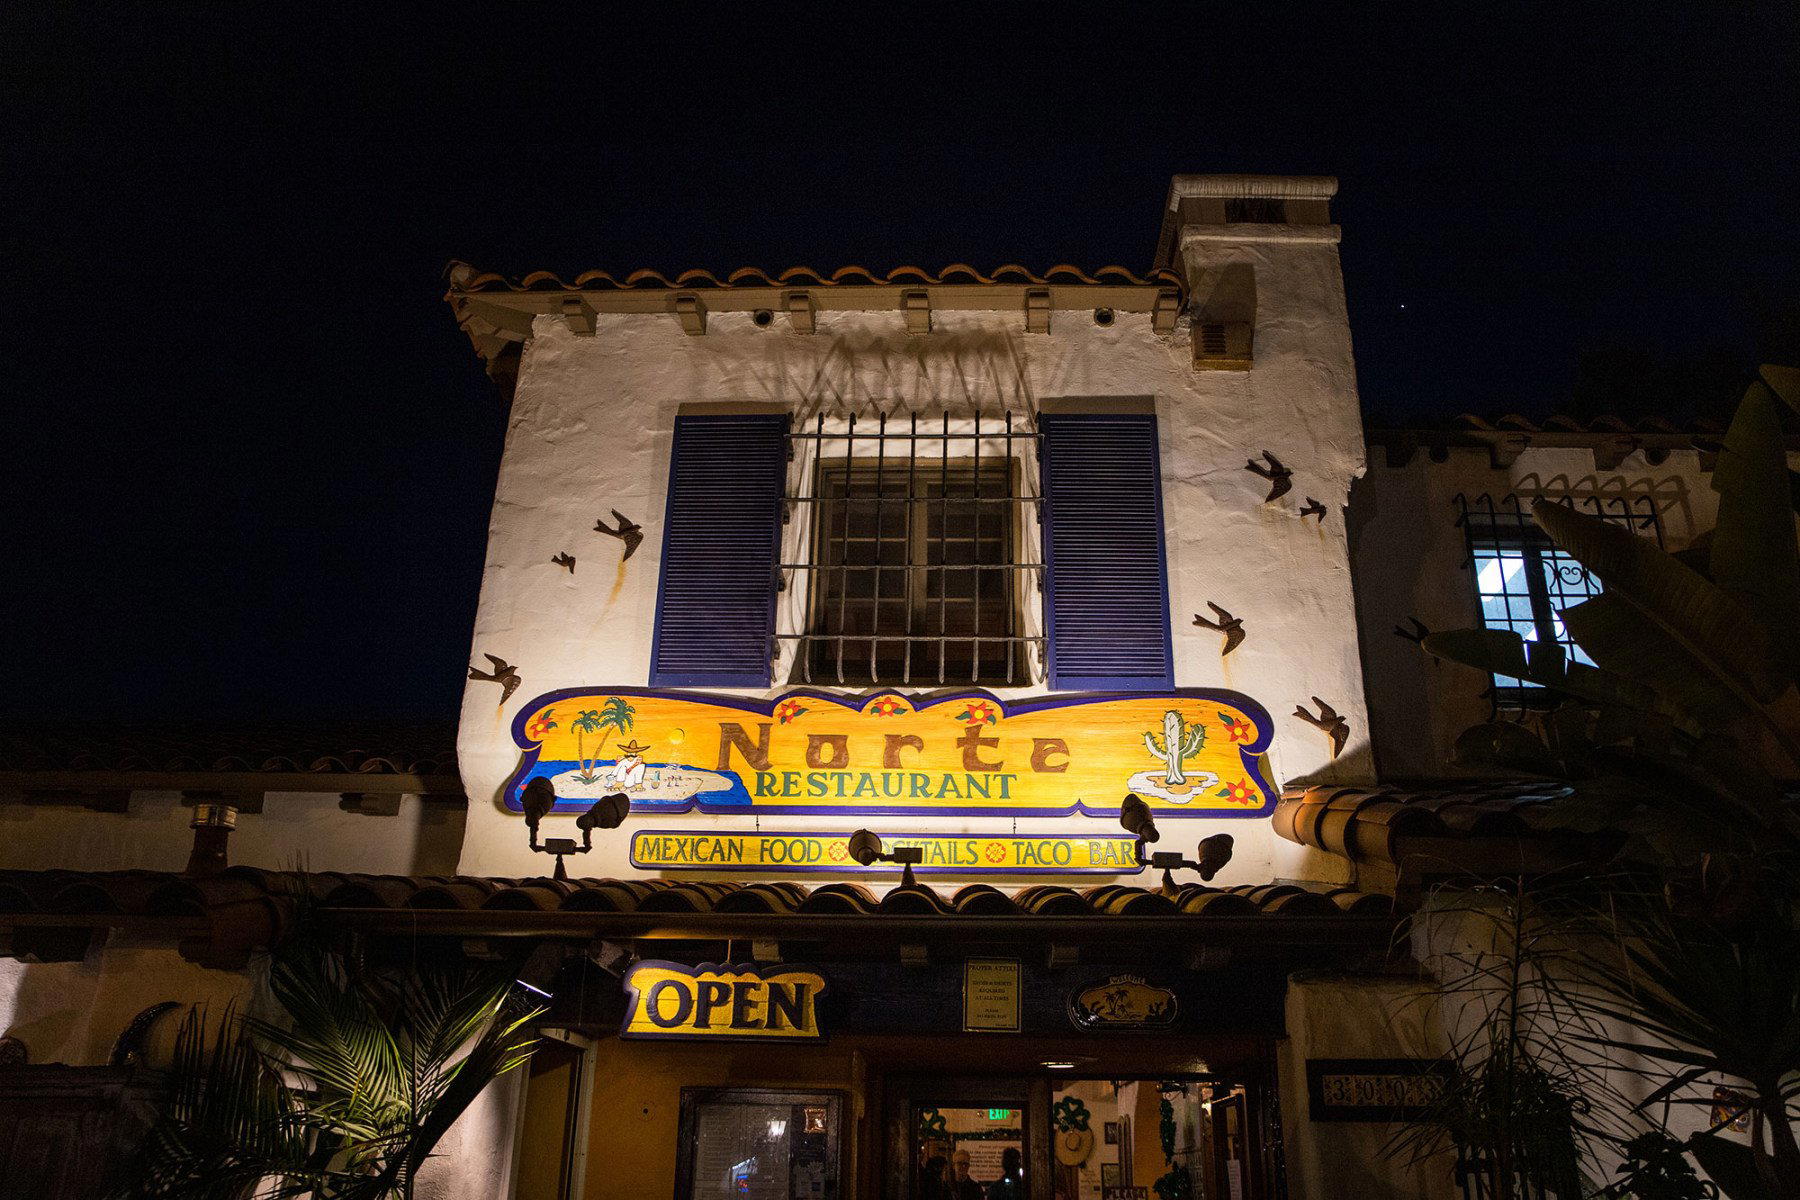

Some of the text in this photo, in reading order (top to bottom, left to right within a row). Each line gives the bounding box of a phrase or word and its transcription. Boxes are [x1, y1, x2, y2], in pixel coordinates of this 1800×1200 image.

[716, 722, 1070, 773] Norte
[754, 771, 1018, 799] RESTAURANT
[638, 838, 1135, 866] MEXICAN FOOD TAILS TACO BAR
[646, 979, 806, 1031] OPEN
